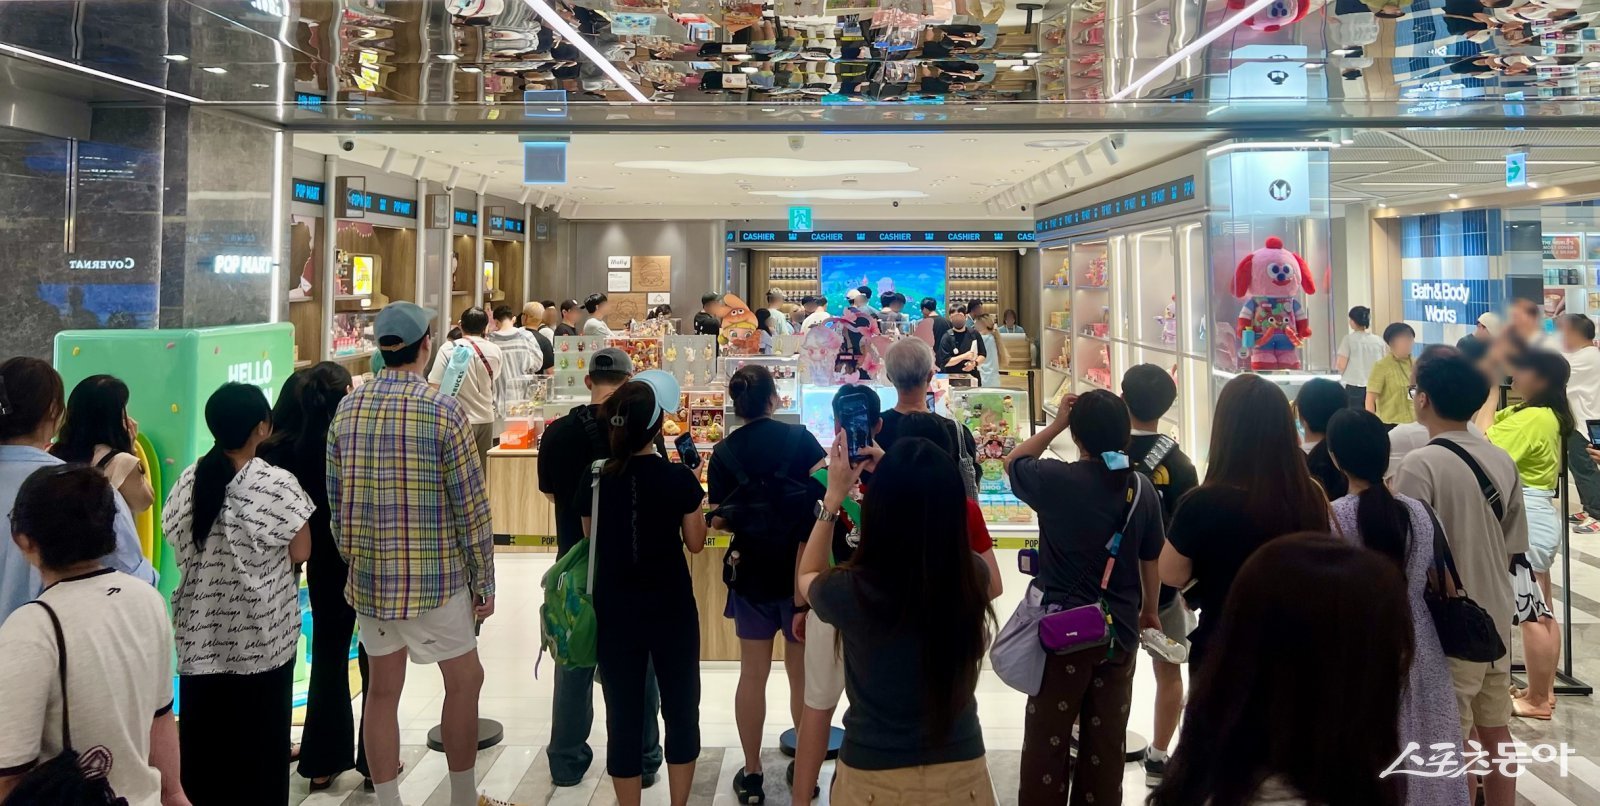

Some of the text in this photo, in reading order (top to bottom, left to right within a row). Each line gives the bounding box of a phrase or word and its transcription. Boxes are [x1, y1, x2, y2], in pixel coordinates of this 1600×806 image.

[296, 184, 320, 200] POP MART
[743, 233, 775, 241] CASHIER
[811, 233, 843, 241] CASHIER
[879, 233, 912, 241] CASHIER
[948, 233, 980, 241] CASHIER
[214, 254, 273, 274] POP MART
[1424, 305, 1457, 323] Works
[228, 359, 273, 385] HELLO
[541, 537, 555, 545] POP
[703, 538, 715, 546] ART
[1025, 539, 1039, 548] POP
